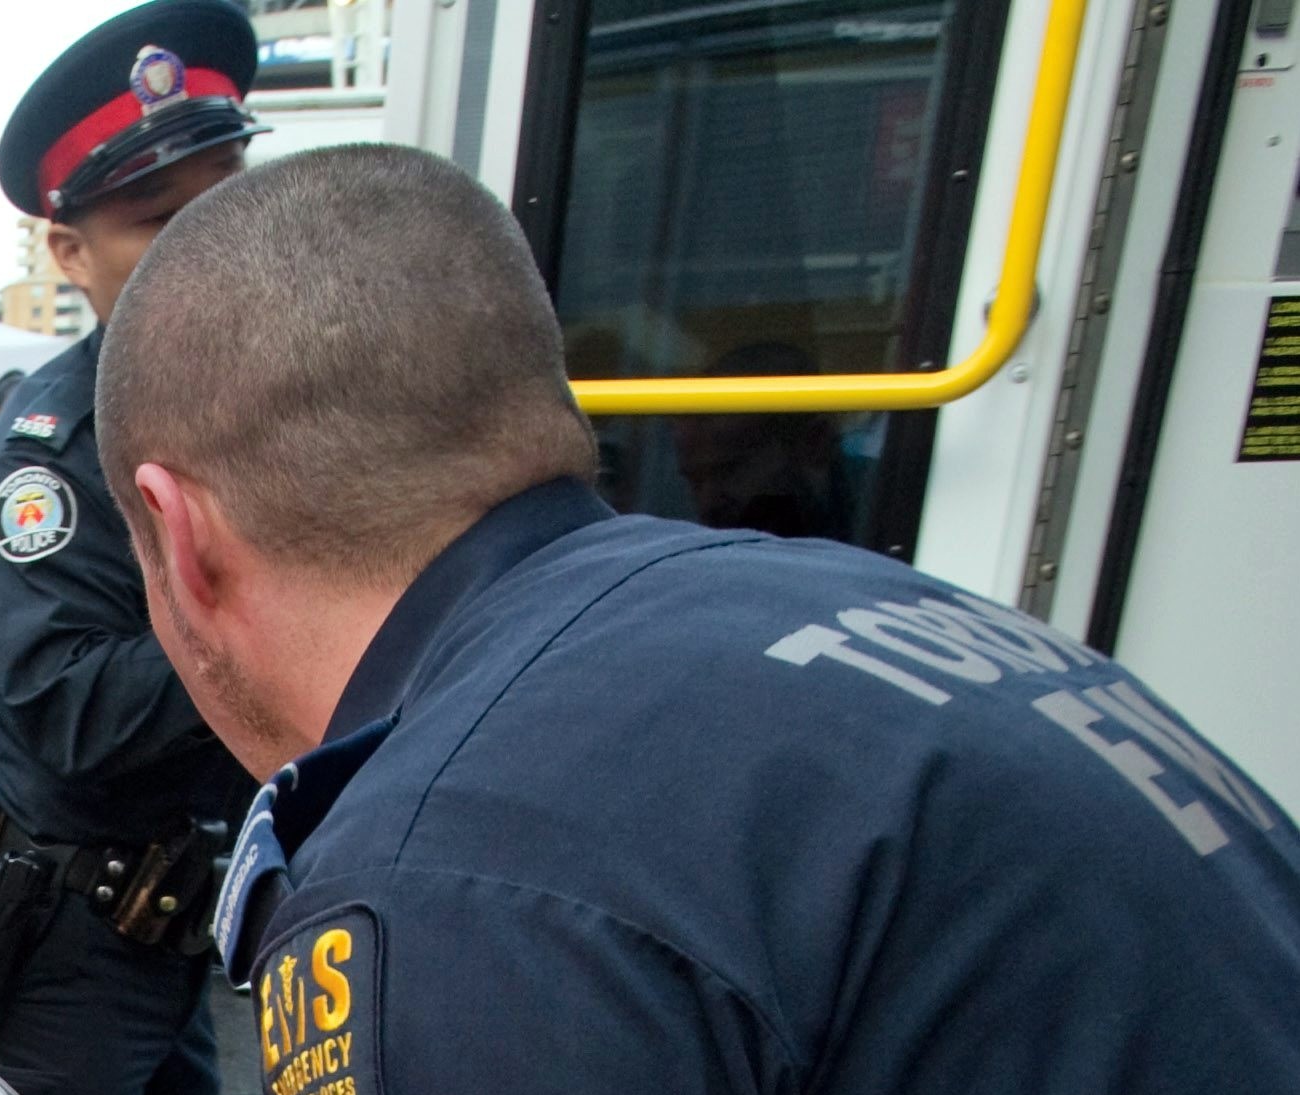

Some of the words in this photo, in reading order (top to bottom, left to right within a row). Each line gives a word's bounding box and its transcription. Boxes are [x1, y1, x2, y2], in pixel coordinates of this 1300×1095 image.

[0, 472, 62, 498] TORONTO
[11, 531, 57, 553] POLICE
[1031, 680, 1276, 856] EM
[261, 928, 352, 1073] EMS
